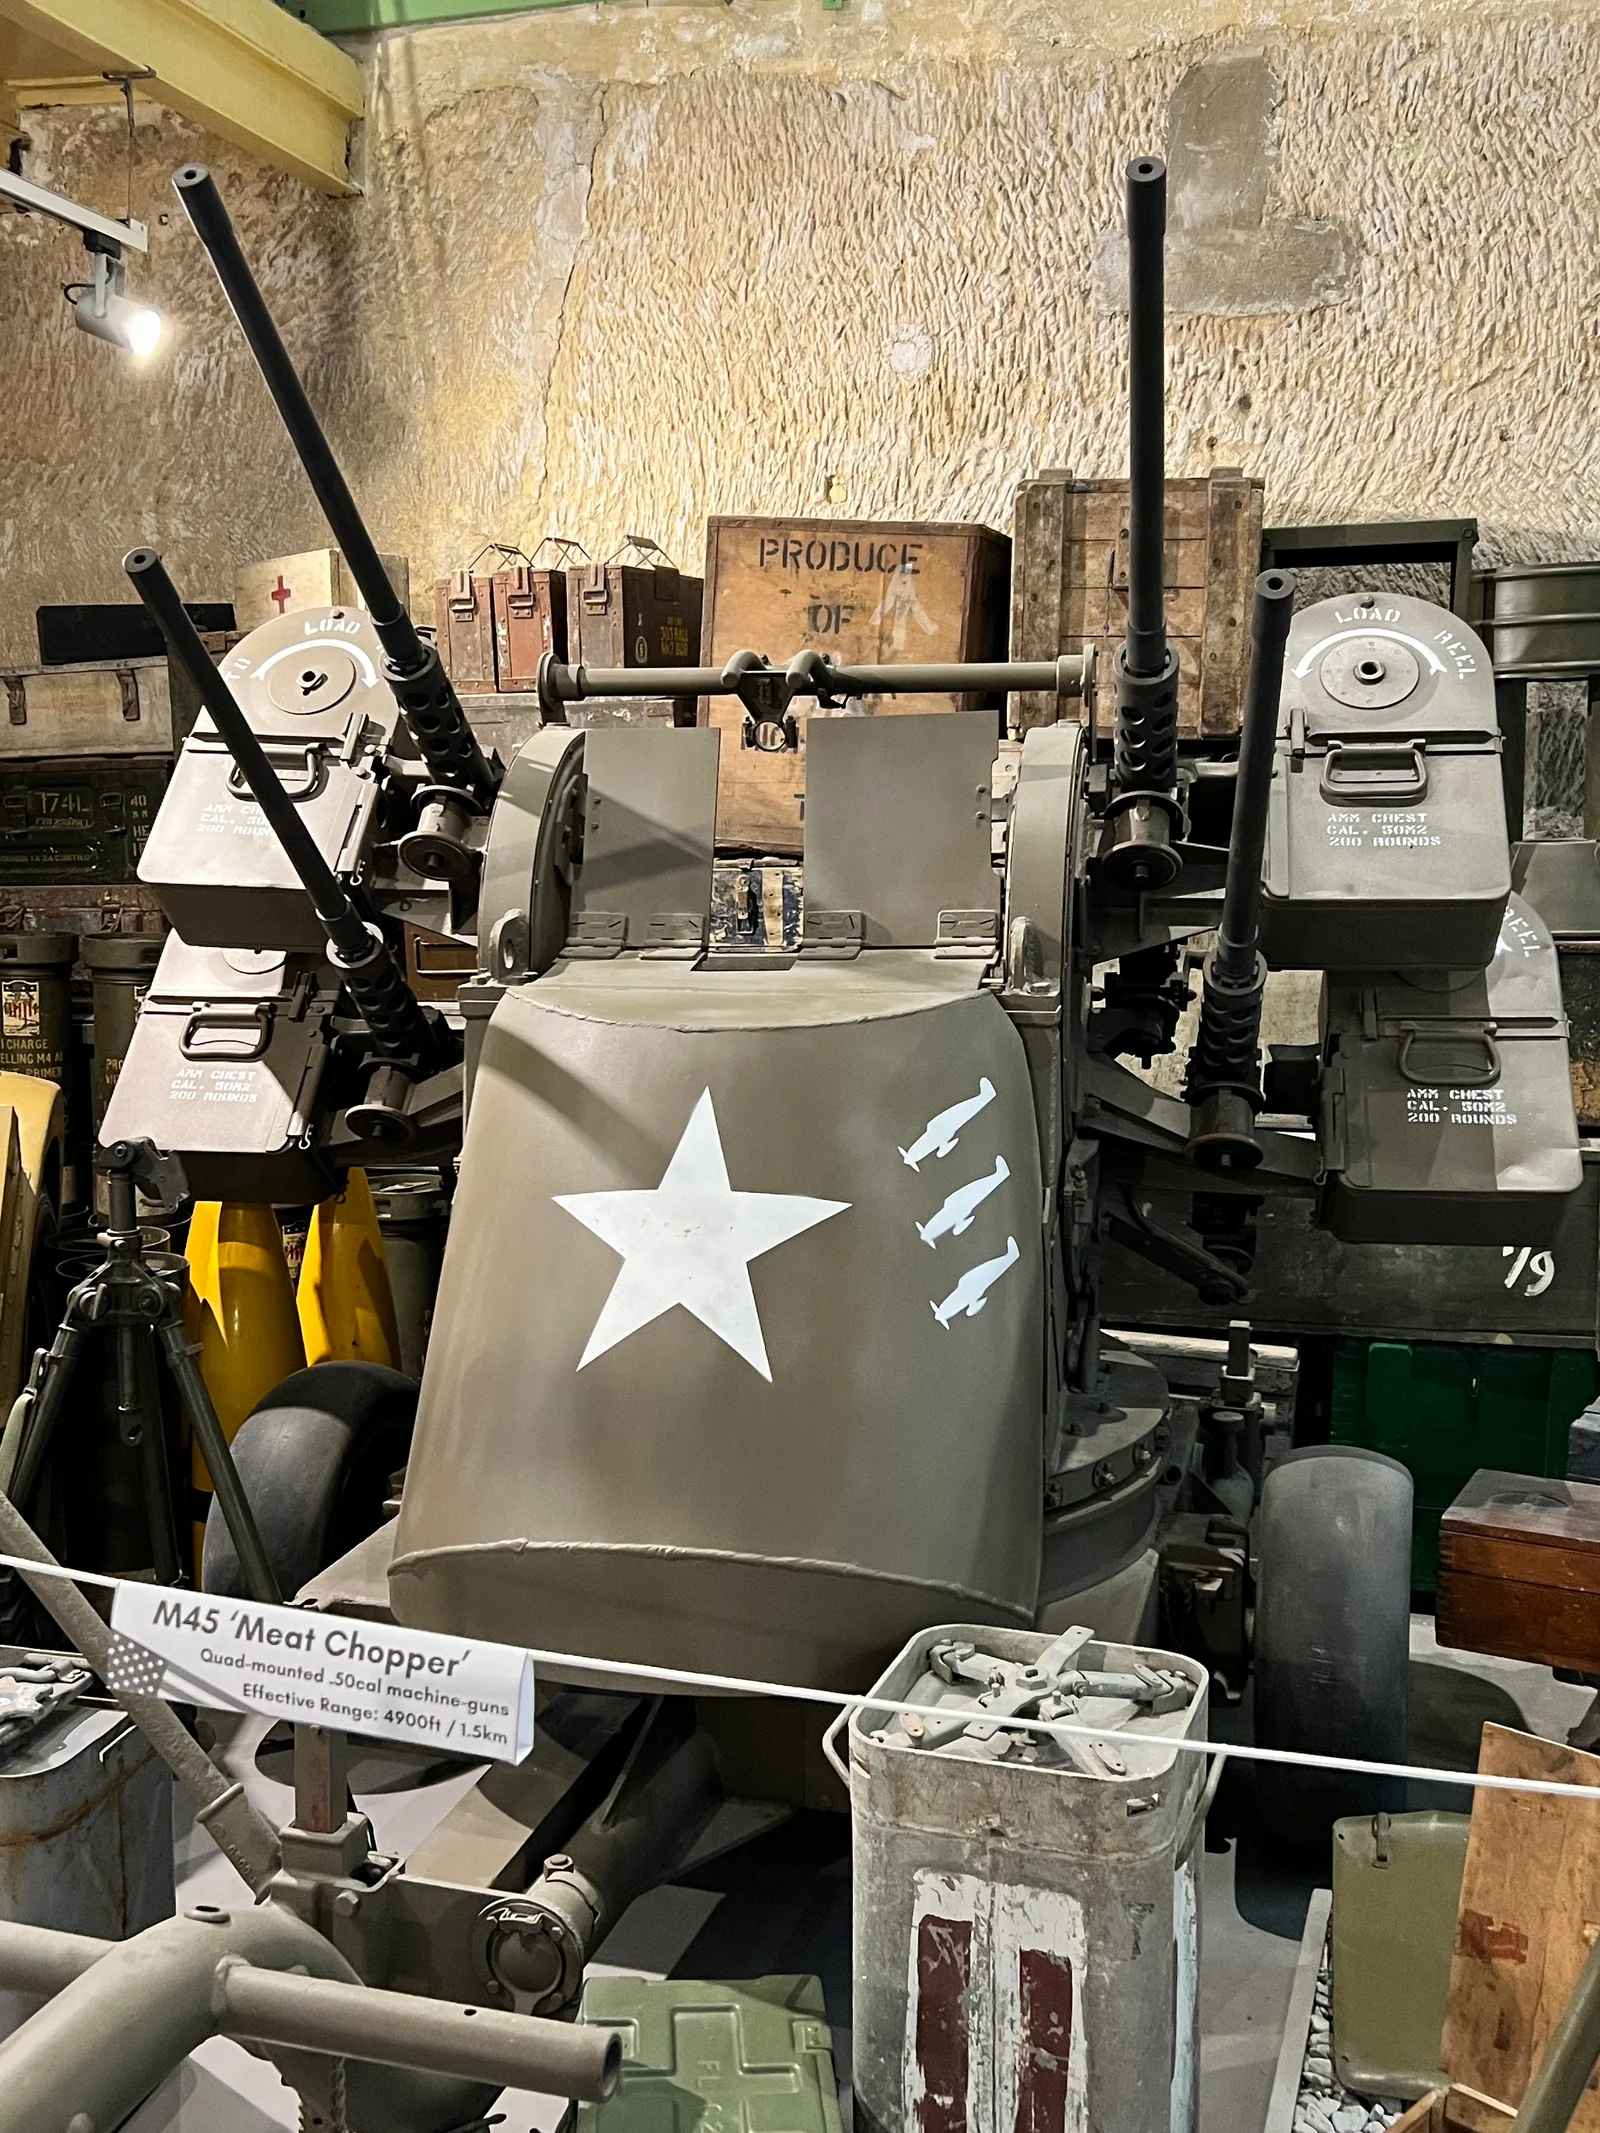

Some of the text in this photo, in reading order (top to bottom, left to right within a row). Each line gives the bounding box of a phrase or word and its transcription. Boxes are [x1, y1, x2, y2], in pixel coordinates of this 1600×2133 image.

[759, 538, 923, 575] PRODUCE
[810, 604, 855, 635] OF
[304, 619, 361, 636] LOAD
[1334, 607, 1477, 680] LOAD REEL
[1328, 813, 1428, 823] AMM CHEST
[1327, 825, 1368, 835] CAL.
[1329, 836, 1441, 847] 200 ROUNDS
[6, 1038, 49, 1050] CHARGE
[176, 1068, 256, 1081] AMM CHEST
[171, 1080, 204, 1090] CAL.
[169, 1090, 258, 1103] 200 ROUNDS
[1407, 1089, 1504, 1100] AMM CHEST
[1407, 1100, 1448, 1111] CAL.
[1407, 1112, 1518, 1125] 200 ROUNDS
[152, 1600, 472, 1678] M45 'Meat Chopper'
[201, 1648, 509, 1716] Quad-mounted .50cal machine-guns
[243, 1683, 315, 1709] Effective
[320, 1697, 379, 1721] Range:
[383, 1708, 441, 1732] 4900ft
[460, 1722, 508, 1745] 1.5km
